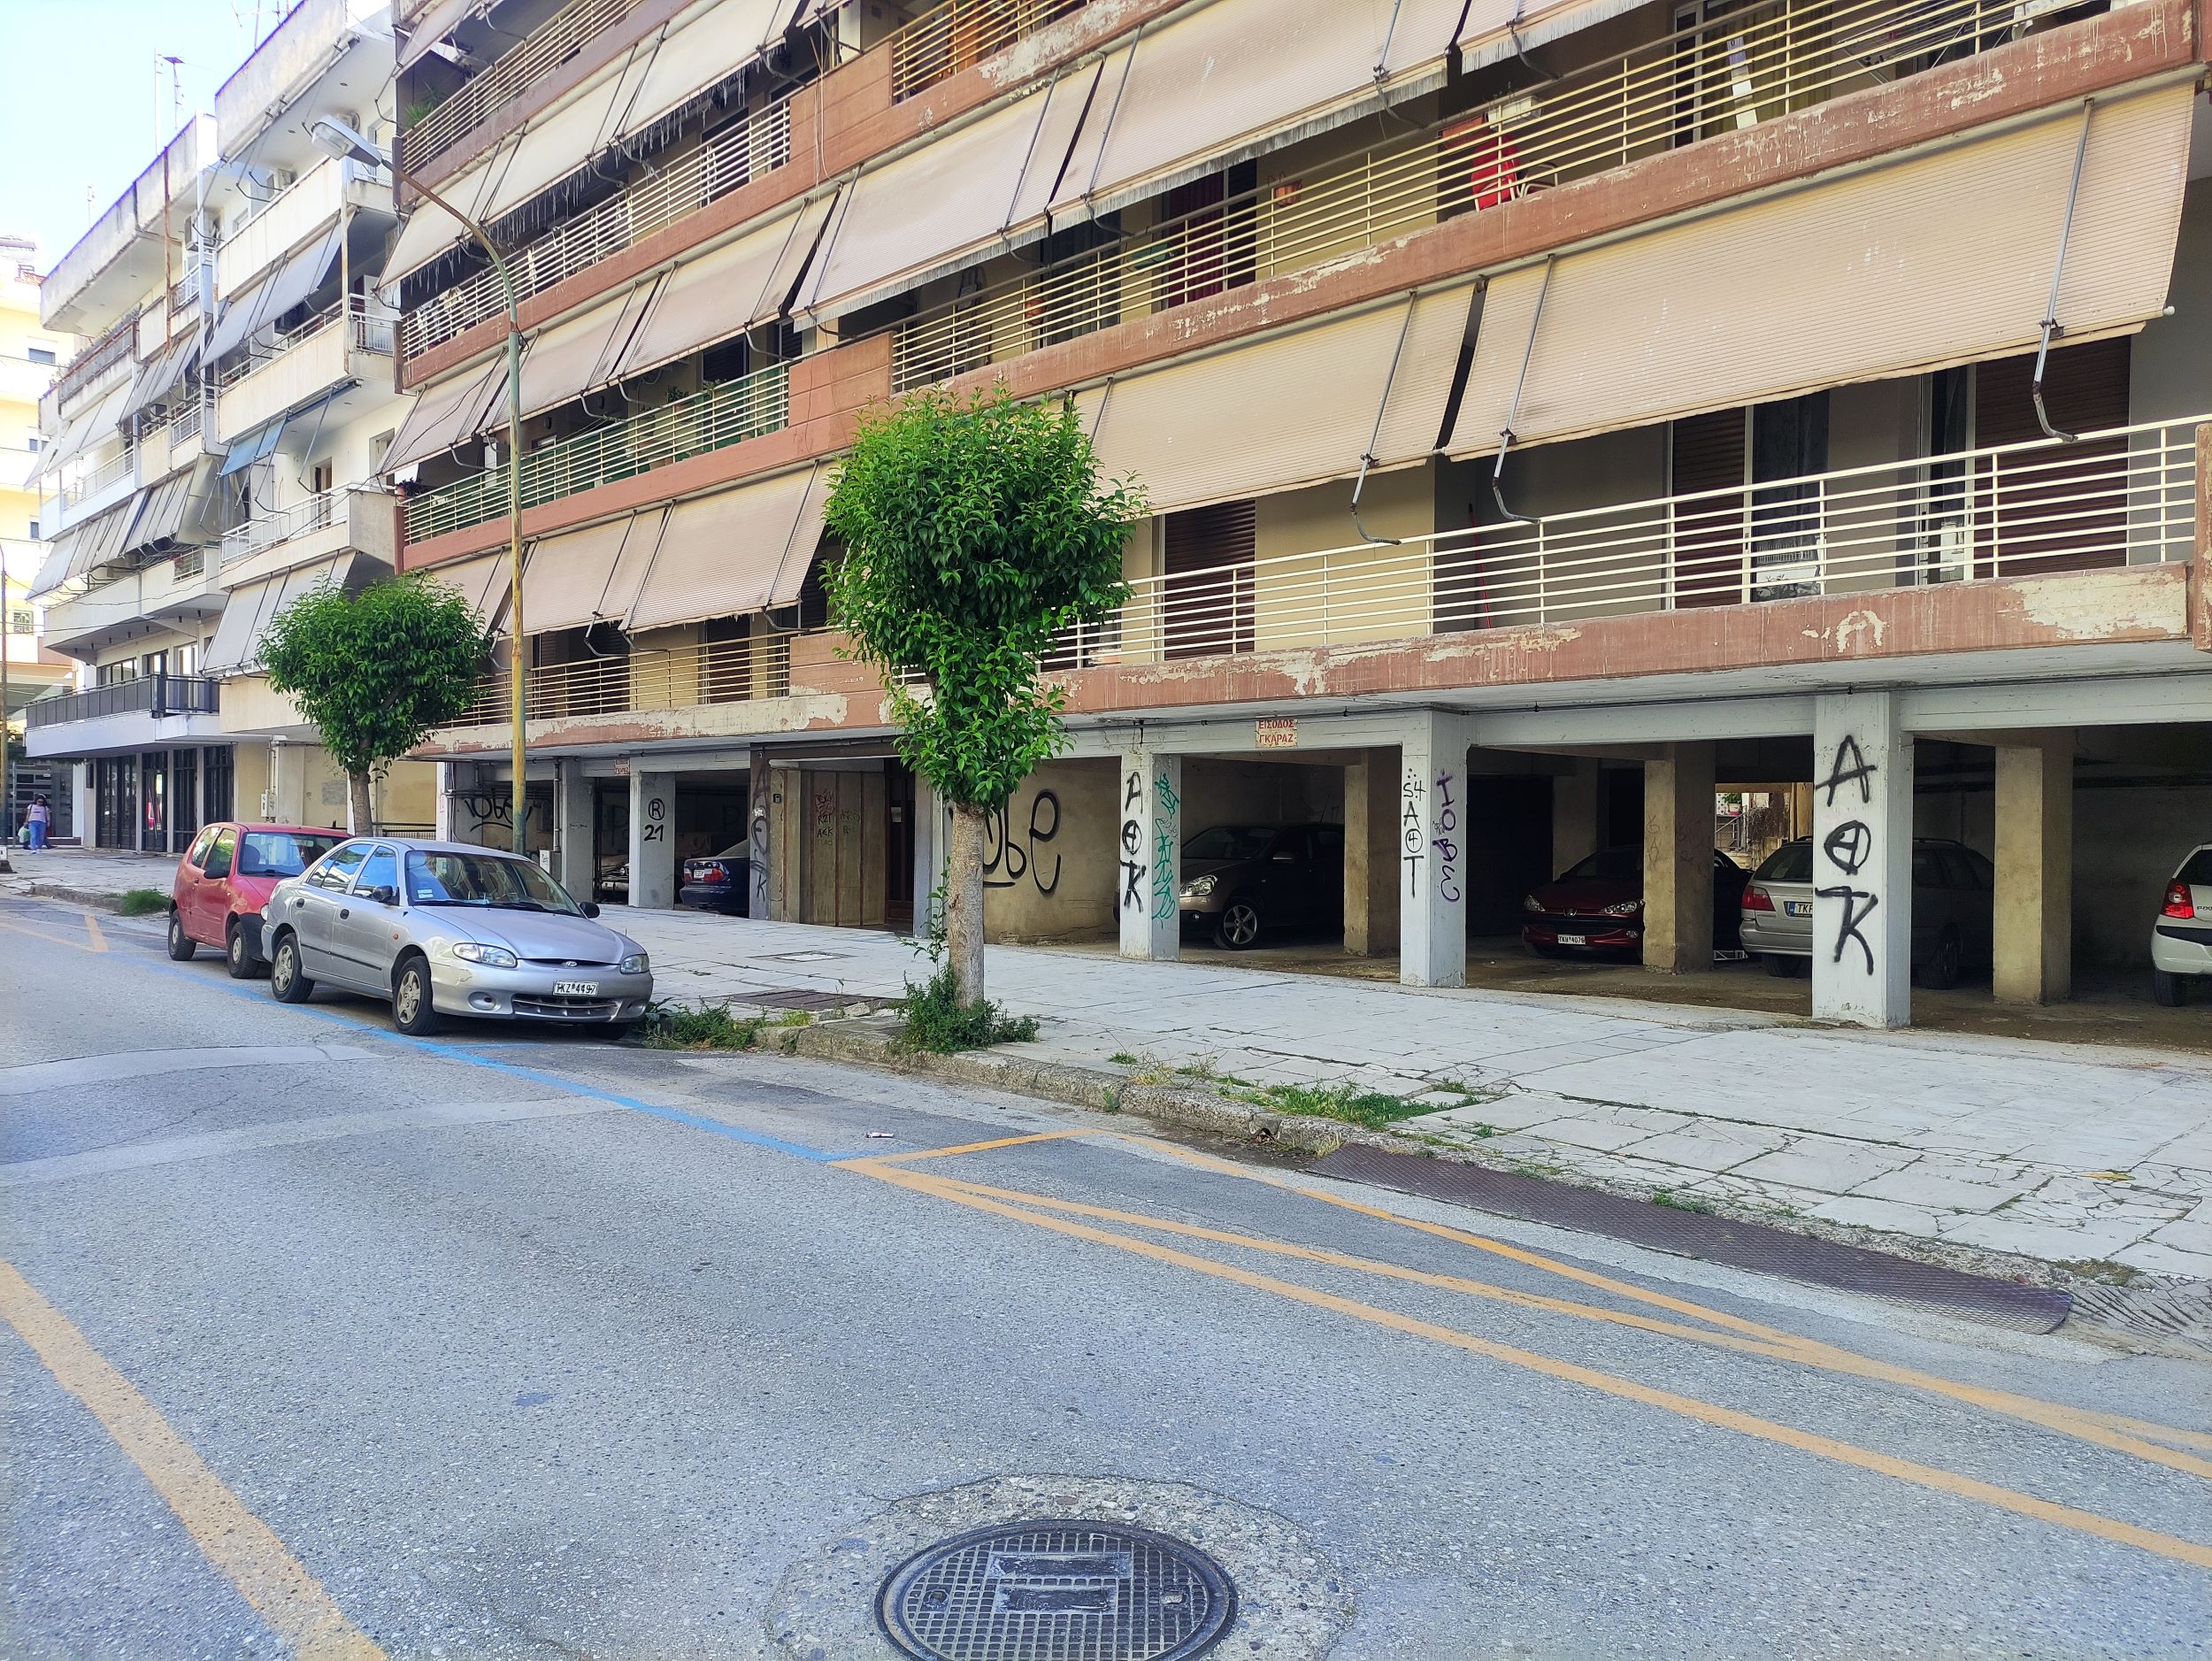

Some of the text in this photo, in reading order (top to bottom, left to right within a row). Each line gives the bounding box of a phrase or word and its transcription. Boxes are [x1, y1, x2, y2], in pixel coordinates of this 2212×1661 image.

[1258, 719, 1294, 729] ΕΙΣΟΔΟΣ
[1259, 734, 1294, 743] ΓΚΑΡΑΖ
[644, 825, 664, 842] 21
